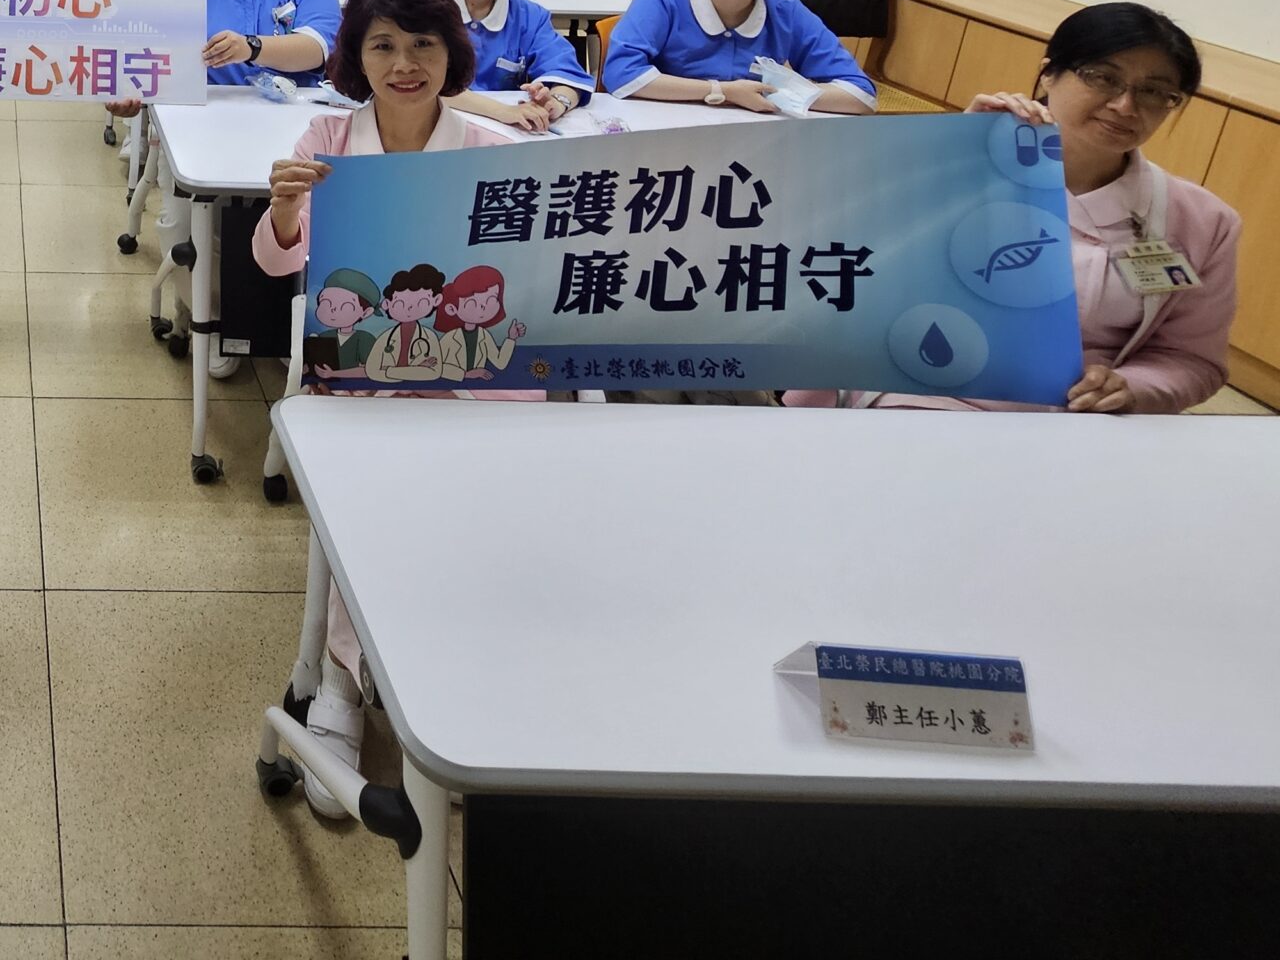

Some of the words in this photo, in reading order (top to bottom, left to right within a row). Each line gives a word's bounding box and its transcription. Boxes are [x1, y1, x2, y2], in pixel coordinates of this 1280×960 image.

[467, 160, 773, 247] 醫護初心
[553, 241, 875, 316] 廉心相守
[560, 356, 746, 379] 臺北榮總桃園分院
[818, 651, 1022, 684] 臺北榮民總醫院桃園分院
